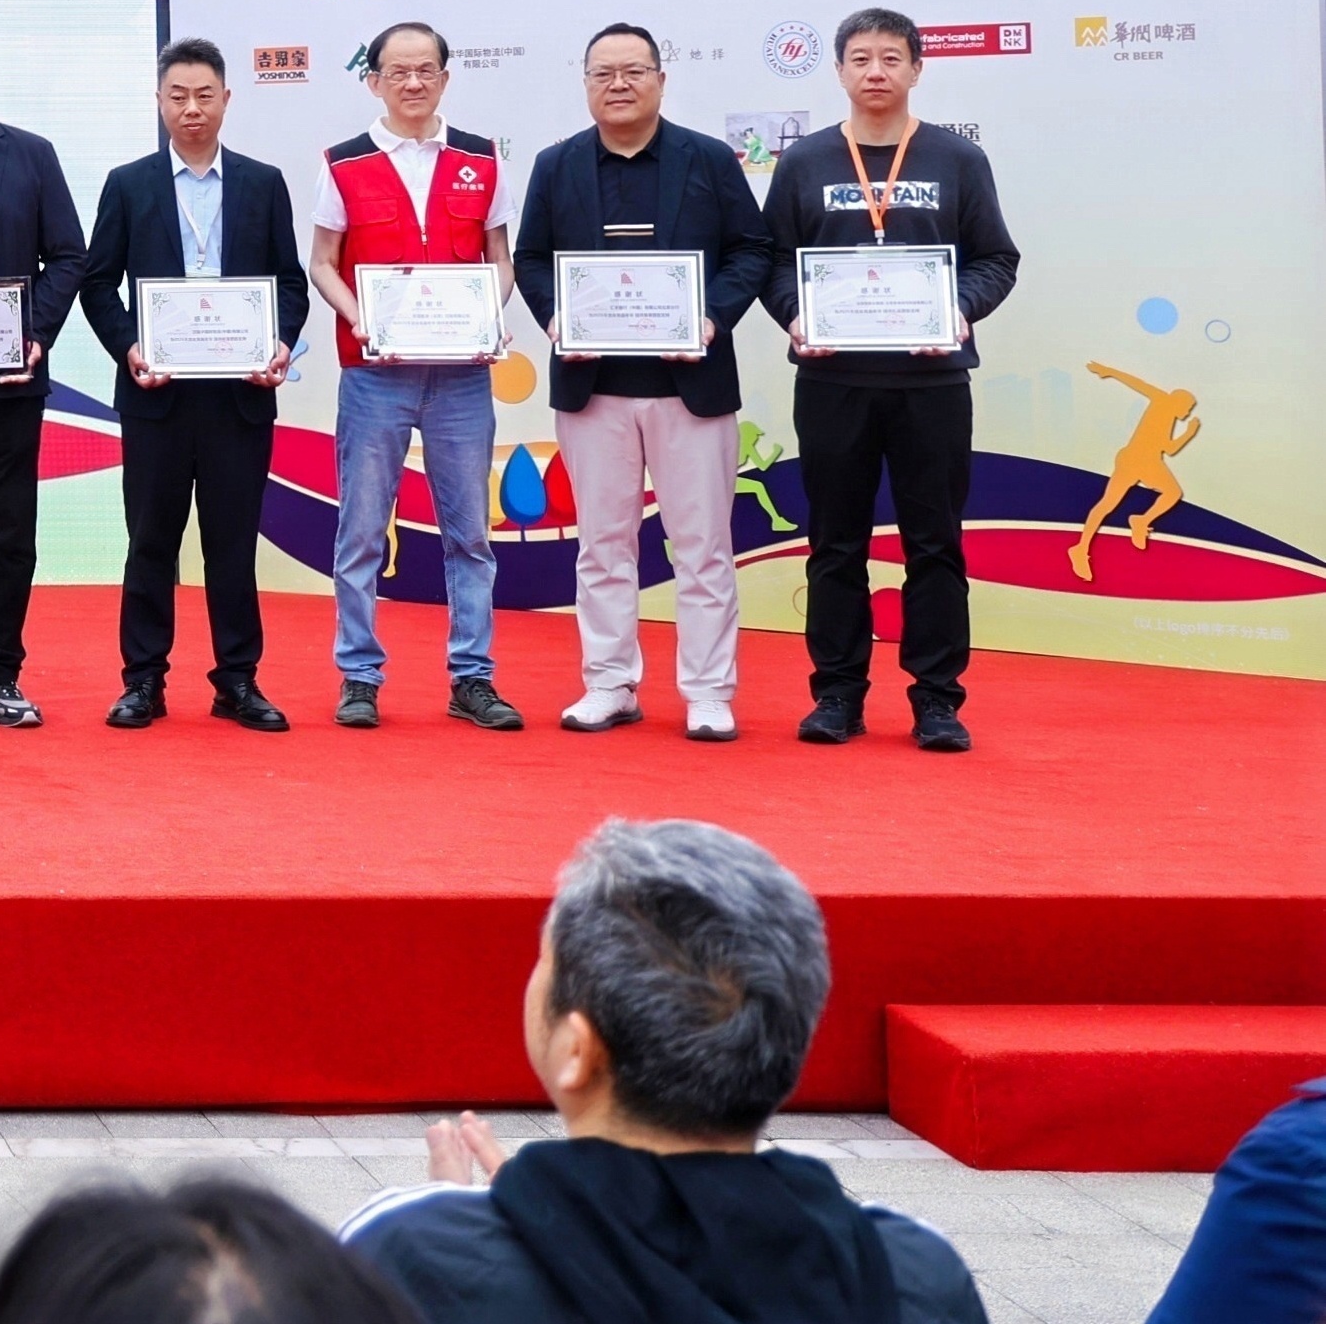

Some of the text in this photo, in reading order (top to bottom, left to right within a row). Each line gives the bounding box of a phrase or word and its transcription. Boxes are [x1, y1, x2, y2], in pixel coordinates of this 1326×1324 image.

[922, 32, 985, 43] fabricated
[942, 42, 985, 50] Construction
[448, 47, 525, 59] 骏华国际物流(中国)
[1114, 51, 1164, 62] CR BEER
[463, 59, 499, 70] 有限公司
[830, 186, 935, 205] MOTAIN
